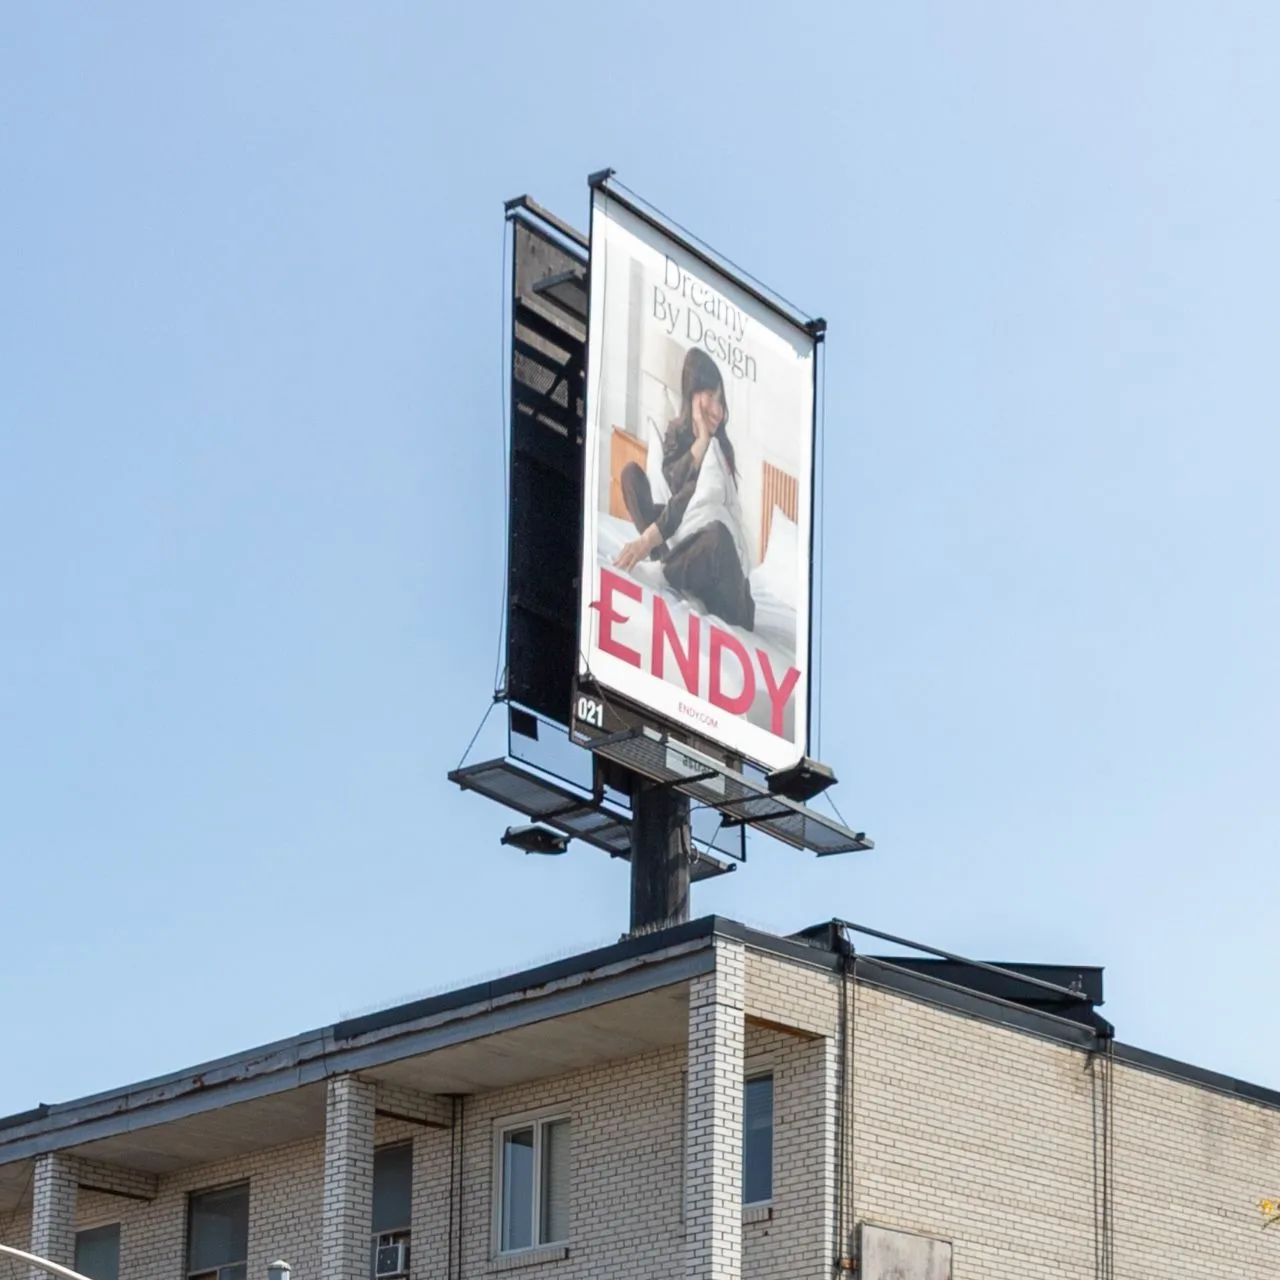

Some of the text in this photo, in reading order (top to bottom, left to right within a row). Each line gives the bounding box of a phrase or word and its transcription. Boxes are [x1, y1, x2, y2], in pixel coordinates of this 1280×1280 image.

[653, 286, 757, 383] By Design
[664, 255, 748, 342] Dreamy
[588, 567, 801, 737] ENDY
[578, 697, 603, 727] 021
